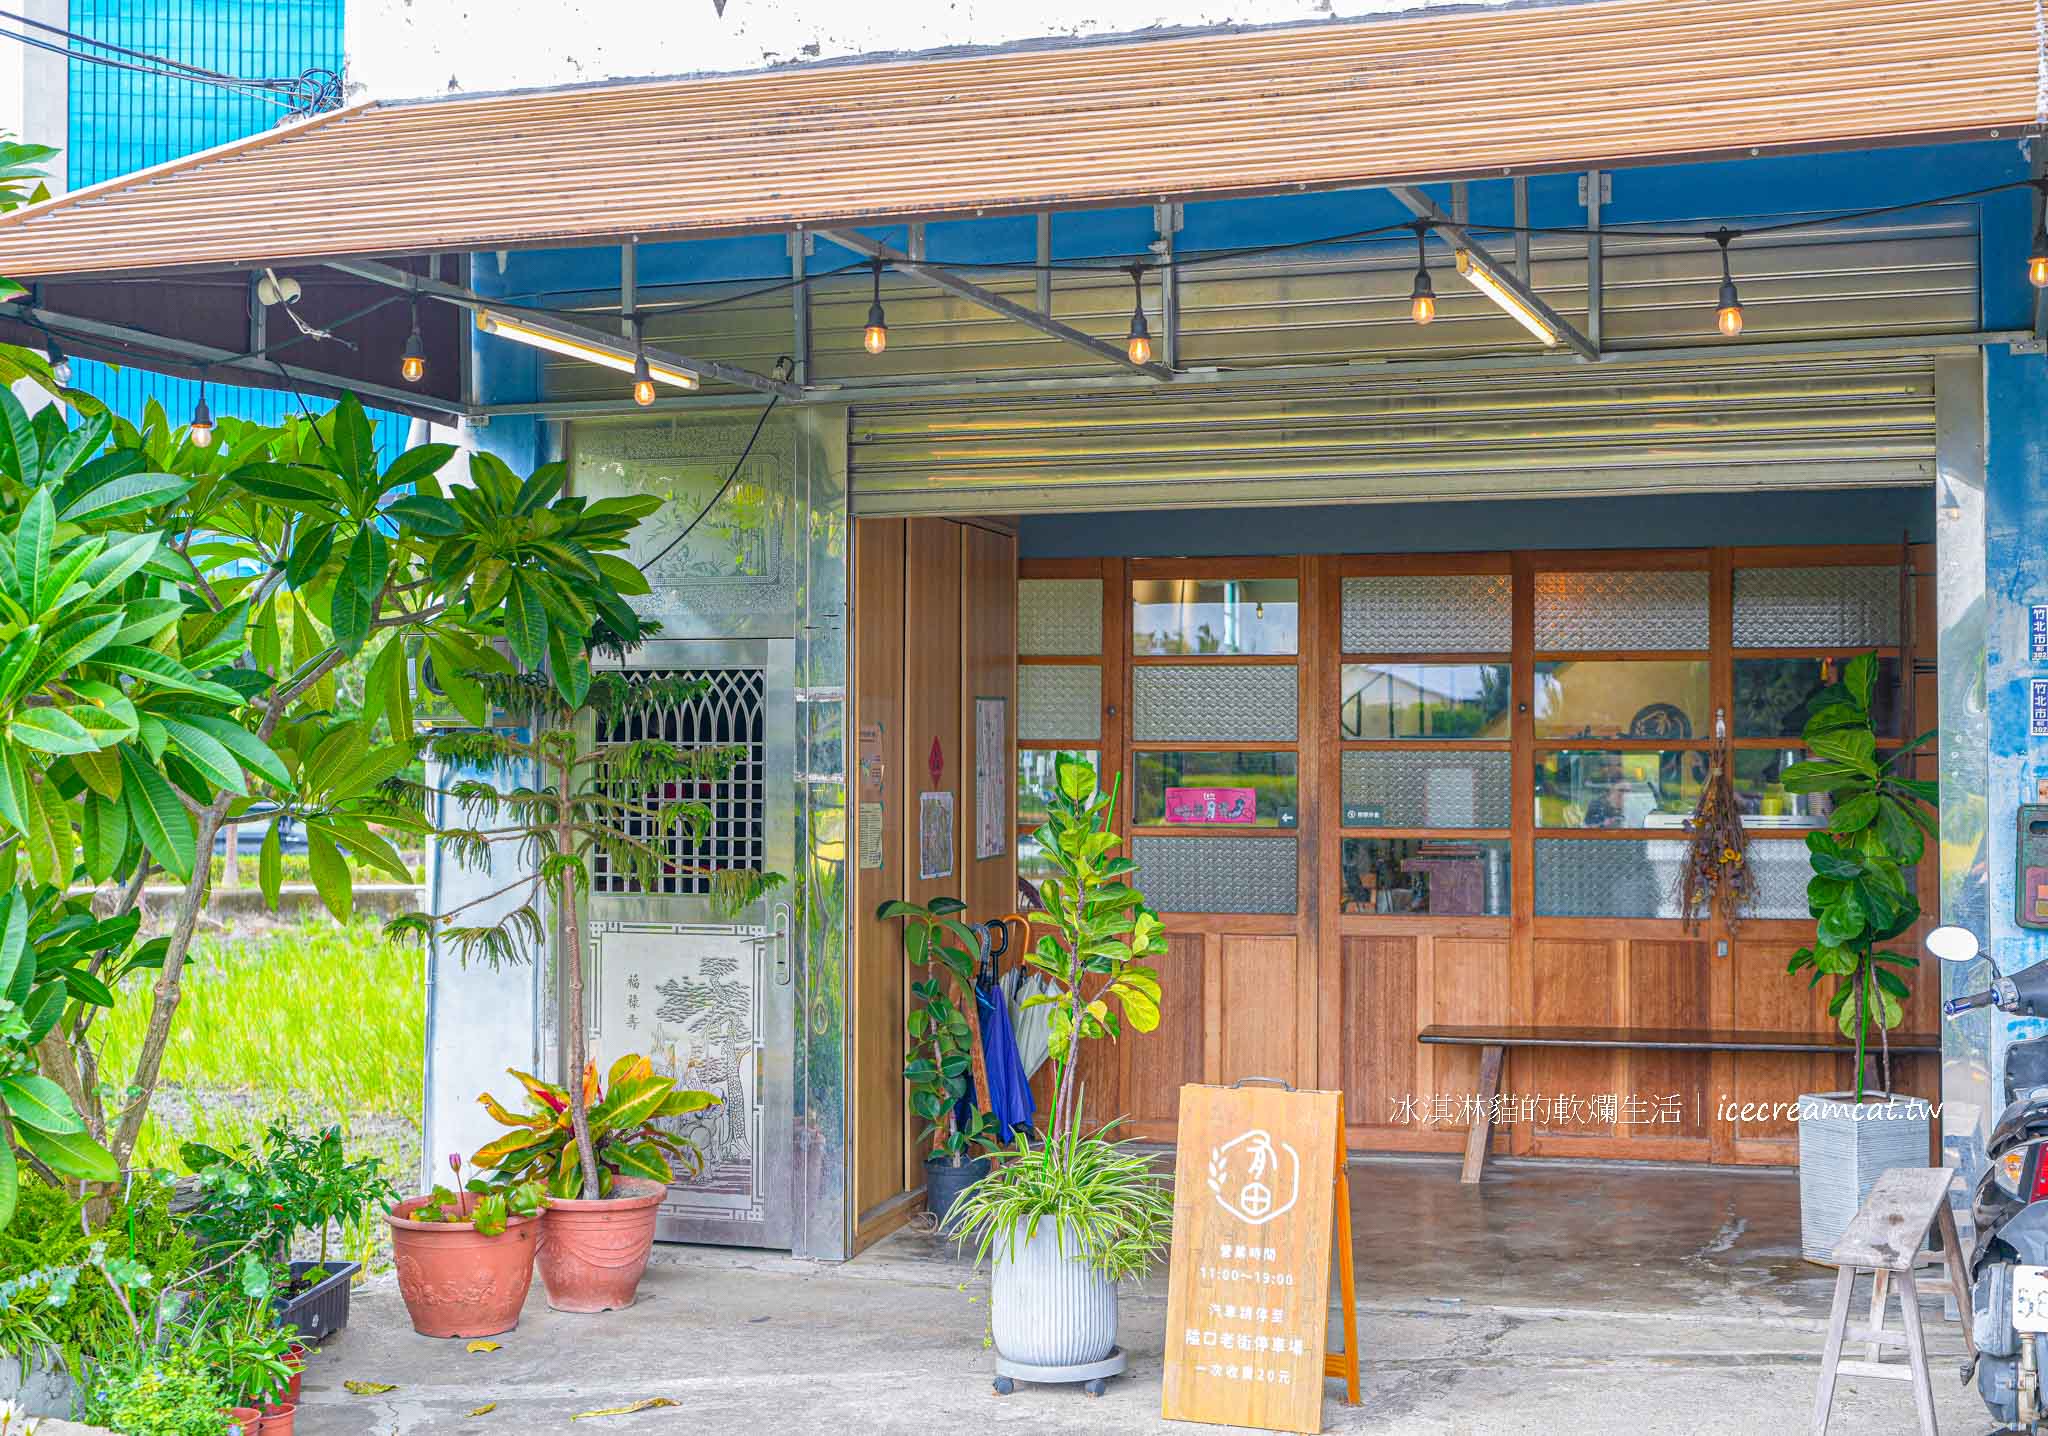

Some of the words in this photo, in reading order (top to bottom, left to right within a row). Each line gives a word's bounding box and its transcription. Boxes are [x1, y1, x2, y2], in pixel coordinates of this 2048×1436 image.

[2033, 608, 2046, 644] 竹北市
[2034, 683, 2047, 719] 竹北市
[1219, 1243, 1277, 1262] 營業時間
[1207, 1303, 1285, 1323] 汽車請停至
[1195, 1363, 1291, 1385] 一次收費20元
